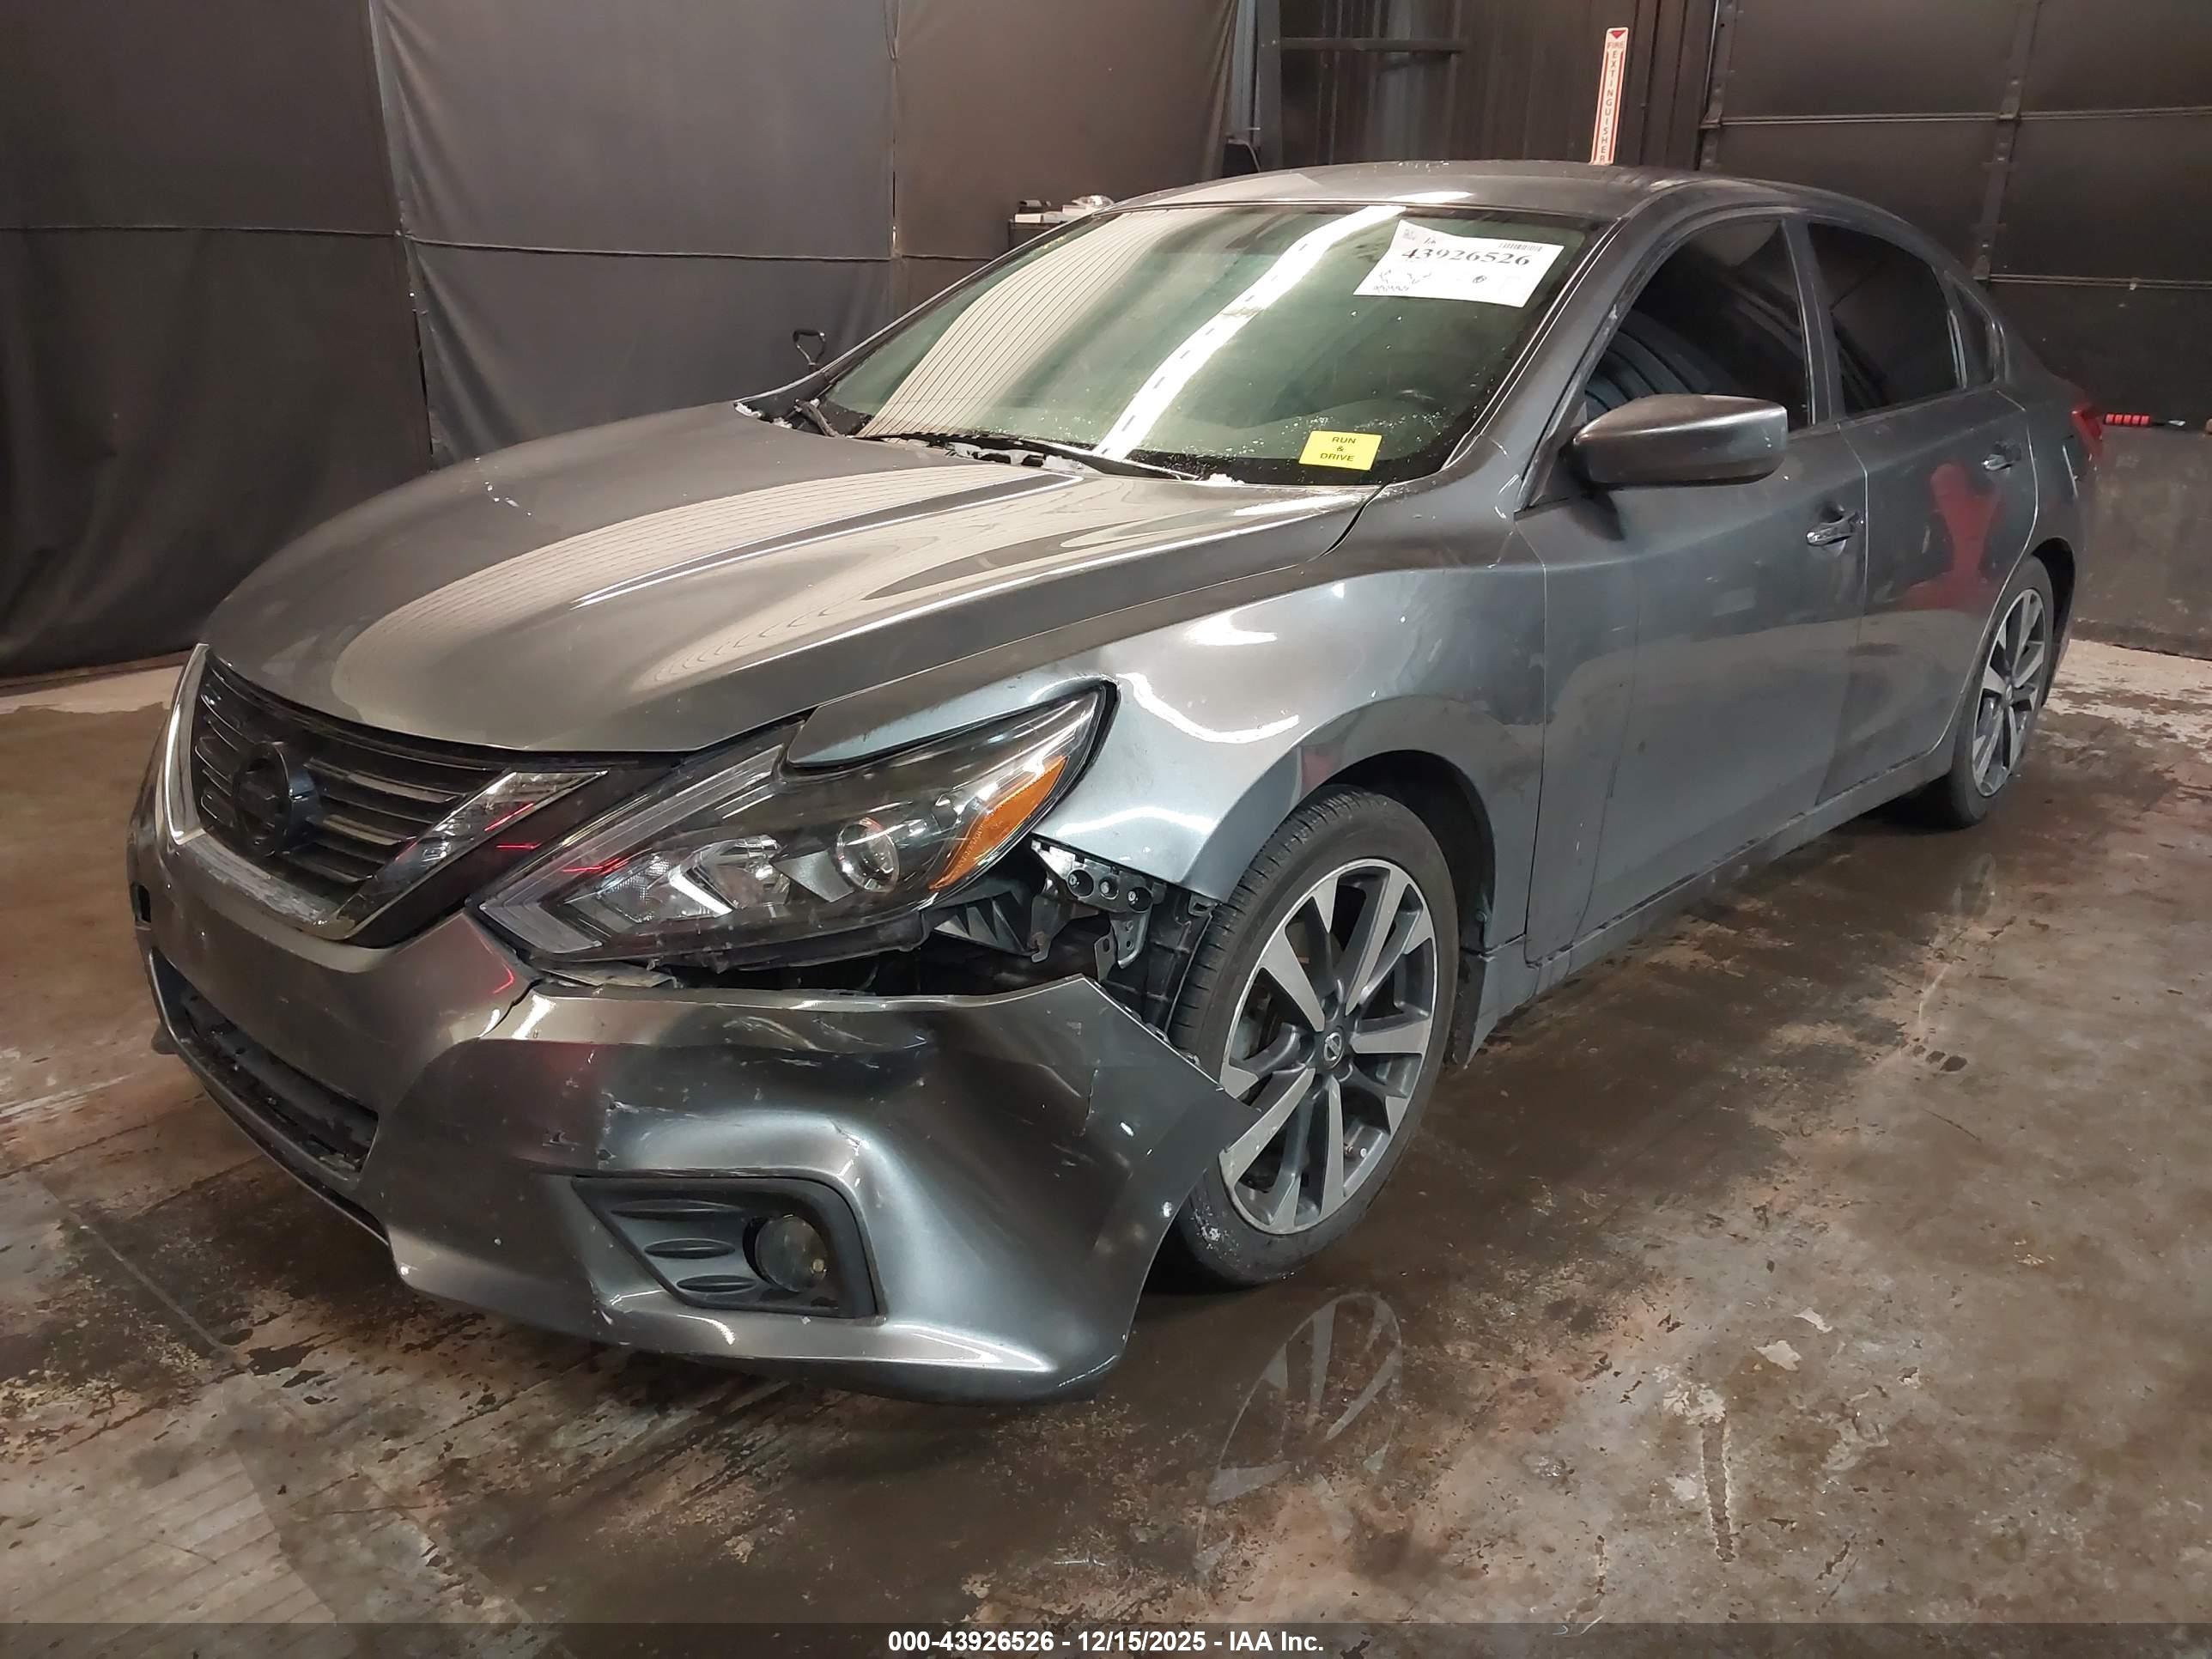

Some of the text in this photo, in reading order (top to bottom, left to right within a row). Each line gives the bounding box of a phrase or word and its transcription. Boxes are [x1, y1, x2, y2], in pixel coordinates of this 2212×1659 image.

[1600, 50, 1617, 161] EXTINGUISHER
[1401, 247, 1530, 266] 43926526
[1320, 453, 1355, 462] DRIVE
